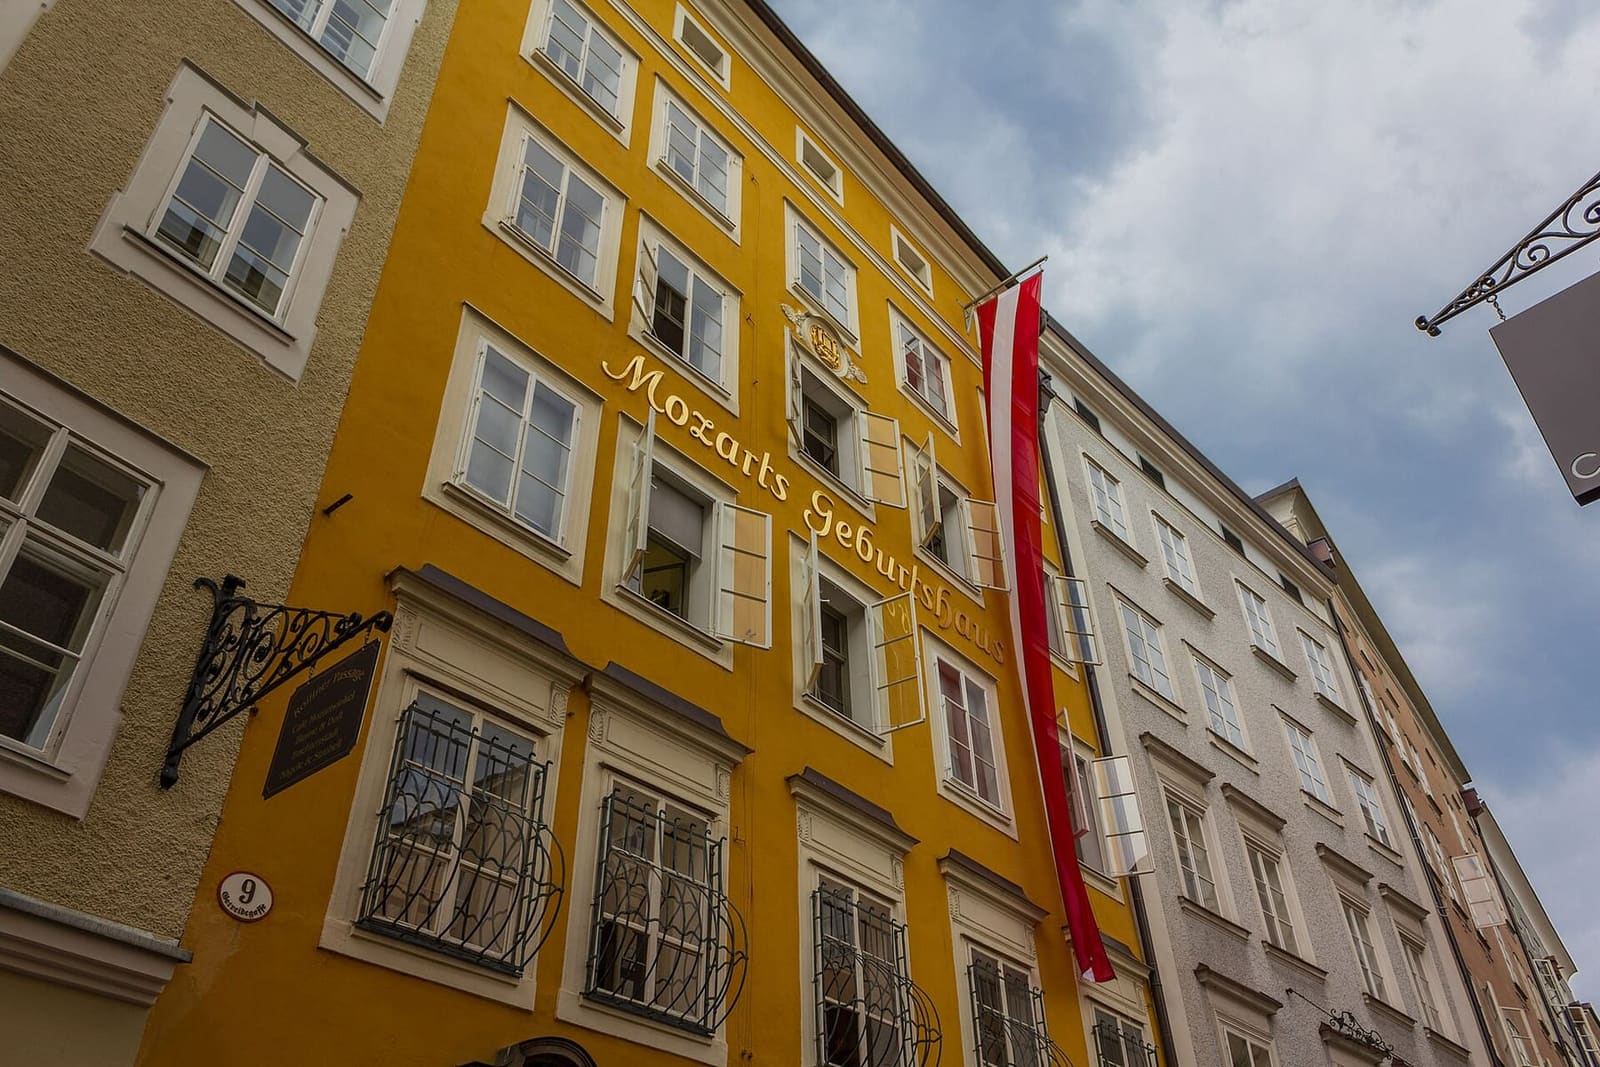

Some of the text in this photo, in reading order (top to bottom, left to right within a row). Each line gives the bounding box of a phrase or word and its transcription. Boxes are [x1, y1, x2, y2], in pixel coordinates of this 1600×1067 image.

[601, 355, 1006, 664] Mozarts Geburtshaus
[238, 878, 256, 904] 9
